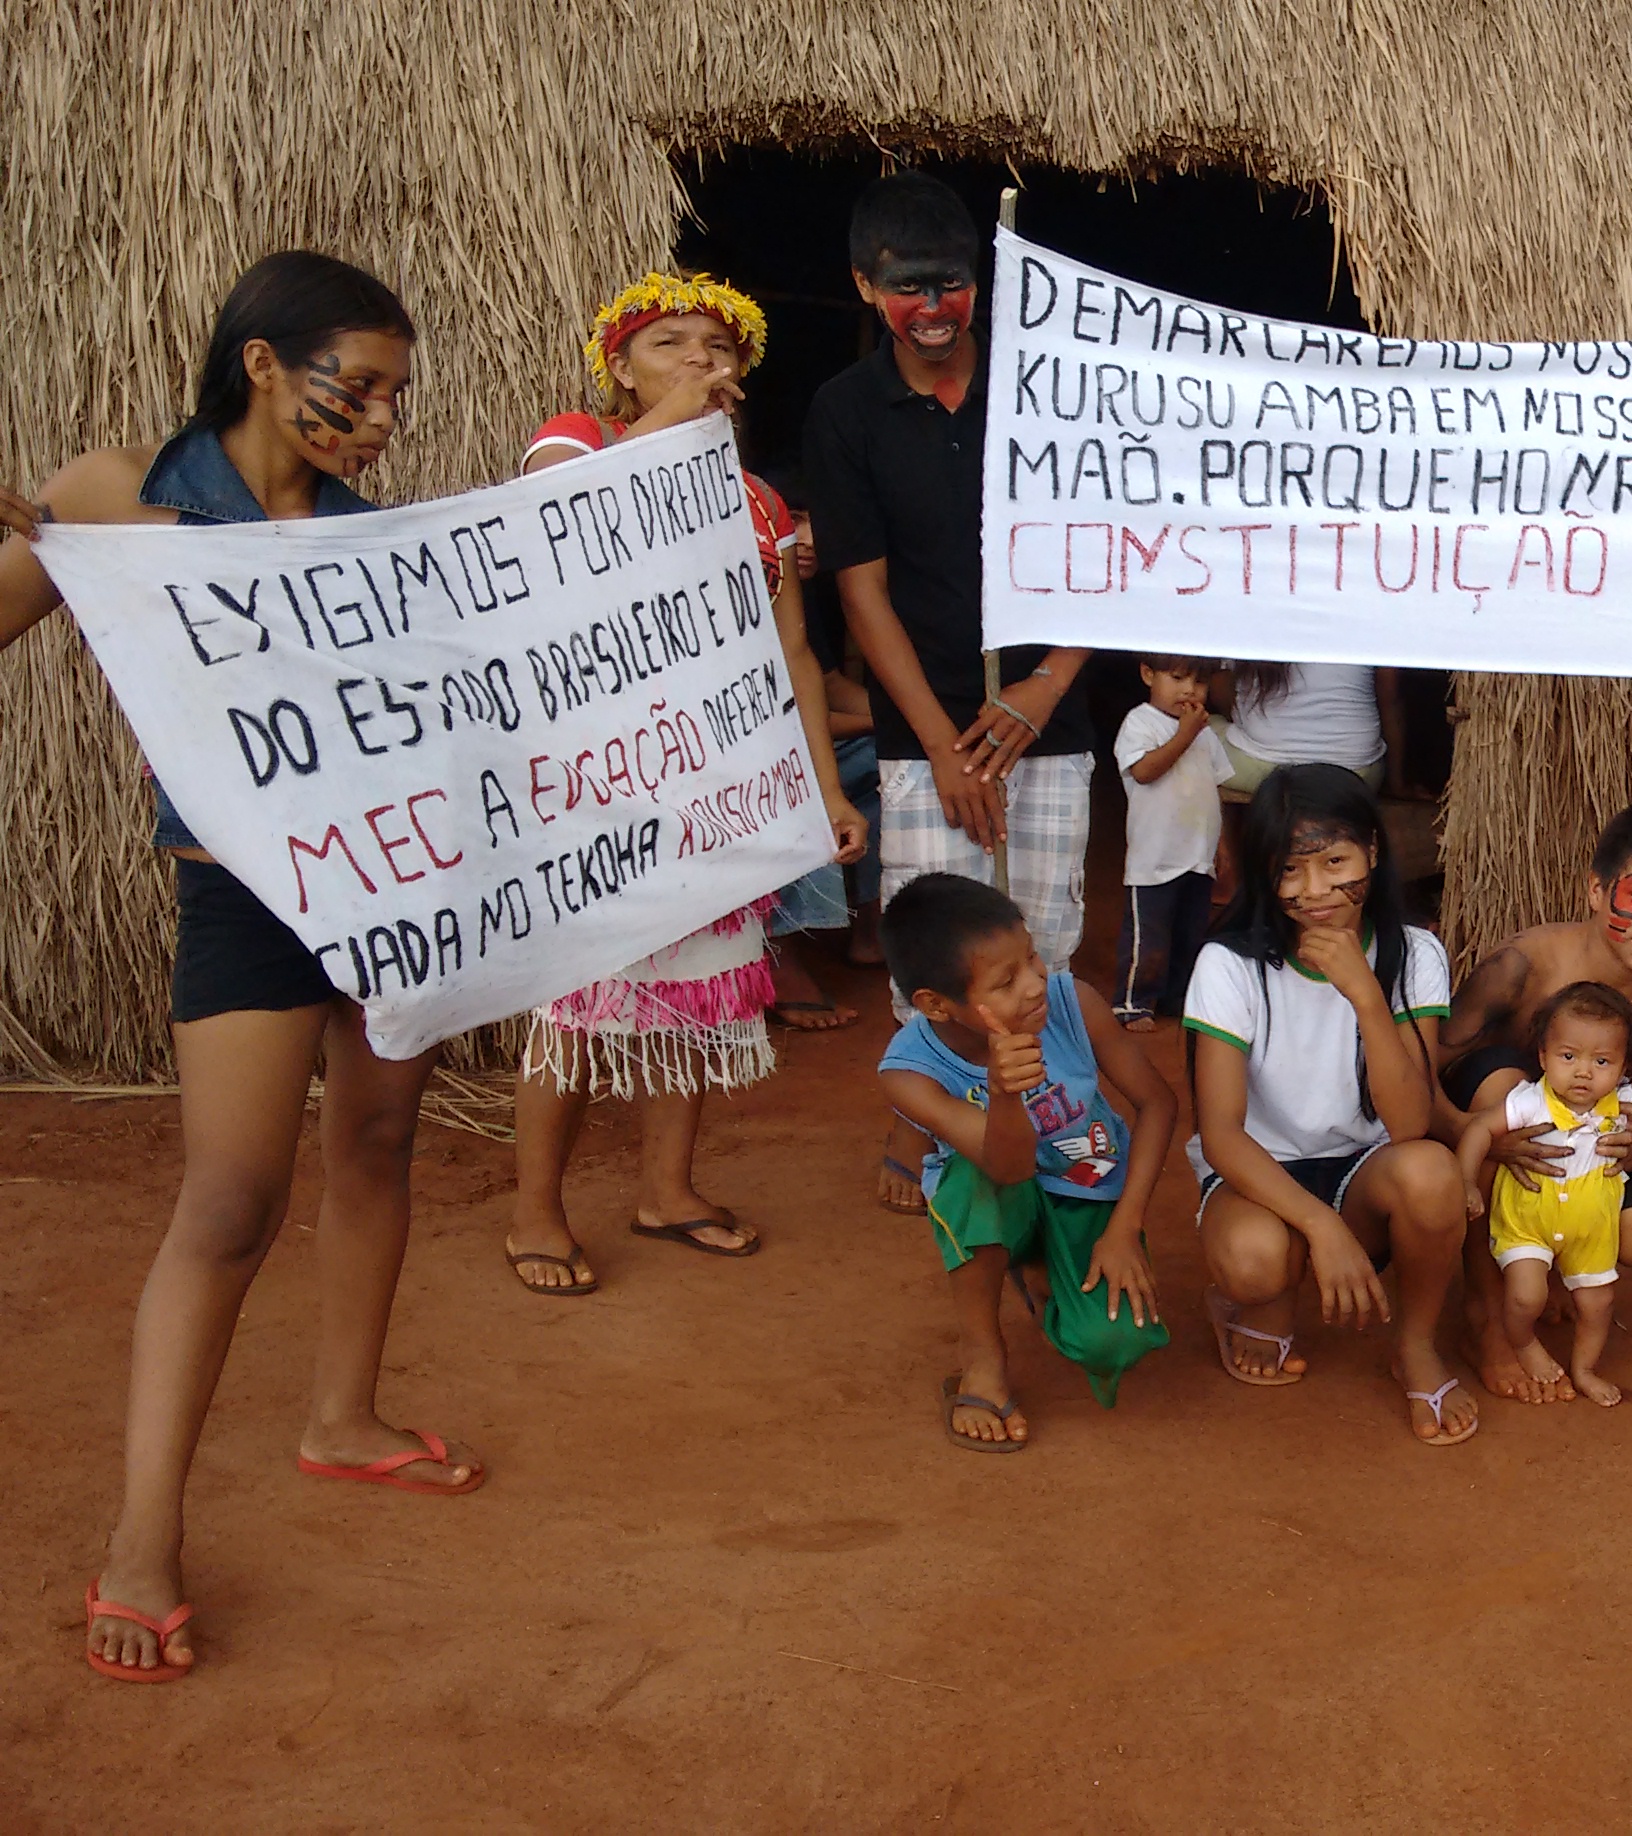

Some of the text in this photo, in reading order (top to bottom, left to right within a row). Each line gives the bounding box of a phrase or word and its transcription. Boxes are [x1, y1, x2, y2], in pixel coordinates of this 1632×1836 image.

[1015, 349, 1235, 429] KURUSU
[1255, 380, 1416, 435] AMBA
[1431, 387, 1506, 435] EM
[1201, 440, 1452, 515] PORQUE
[164, 441, 743, 666] EXIGIMOS POR DIREITOS
[227, 698, 319, 788] DO
[526, 589, 700, 722] BRASILEIRO
[699, 580, 724, 648] E
[725, 561, 760, 637] DO
[288, 788, 463, 914] MEC
[481, 769, 519, 848] A
[479, 878, 531, 958] NO
[535, 817, 660, 925] TEKOHA
